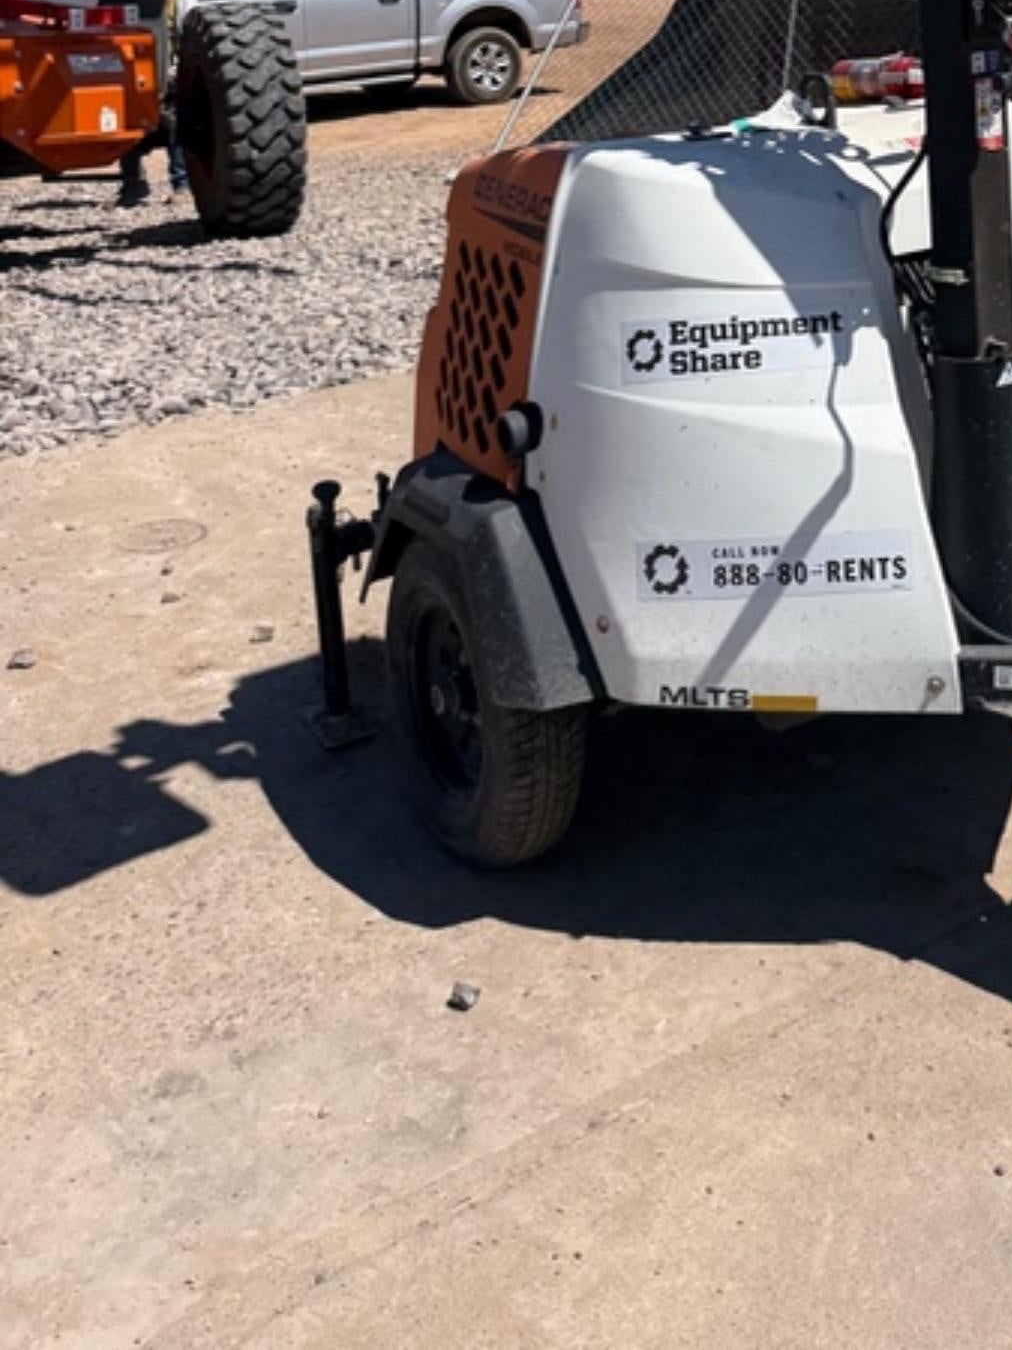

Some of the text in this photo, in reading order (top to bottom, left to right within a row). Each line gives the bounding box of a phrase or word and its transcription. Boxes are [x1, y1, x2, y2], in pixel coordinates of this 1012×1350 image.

[669, 311, 843, 348] Equipment
[669, 349, 762, 375] Share
[711, 546, 780, 558] CALL NOW
[713, 555, 907, 588] 888-80-RENTS
